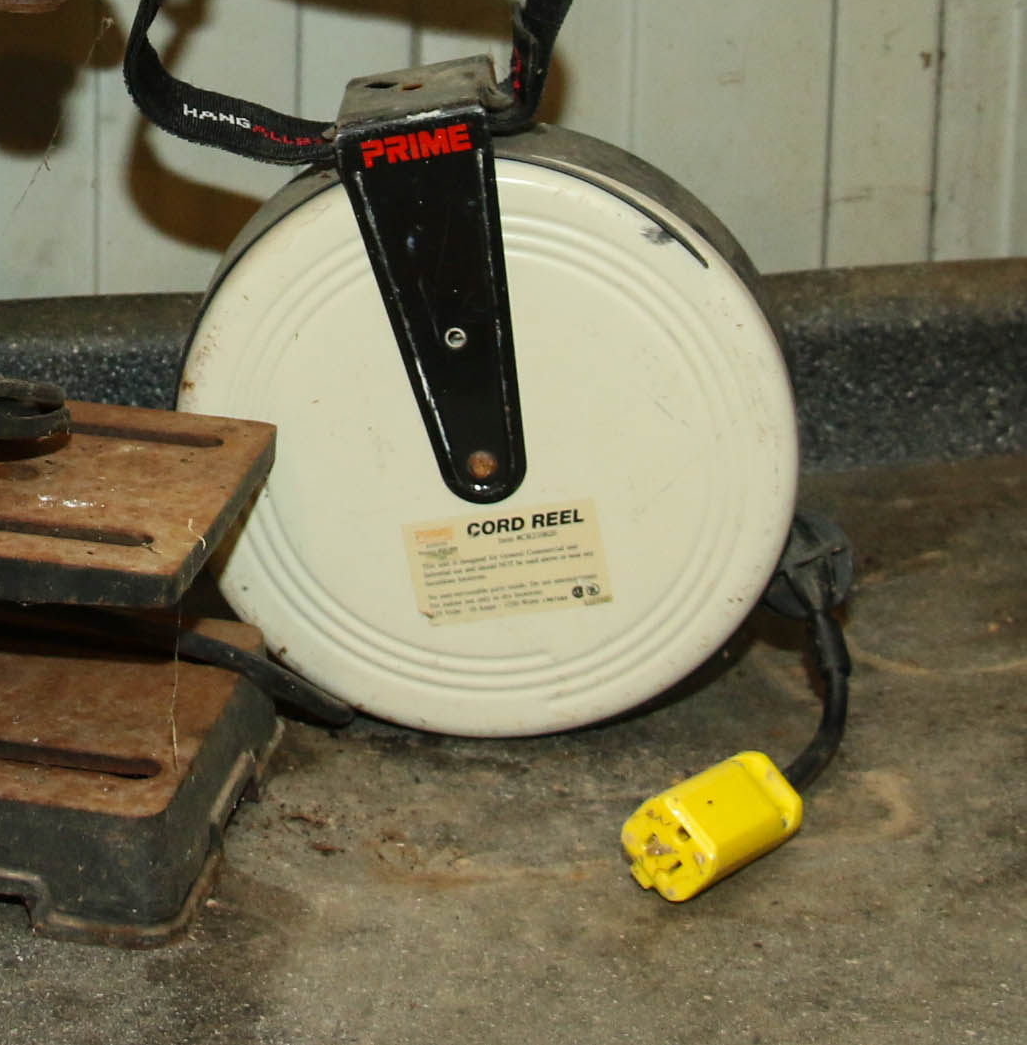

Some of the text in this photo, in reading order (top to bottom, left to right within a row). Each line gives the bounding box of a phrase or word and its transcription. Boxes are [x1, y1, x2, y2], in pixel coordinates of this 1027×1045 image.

[360, 123, 472, 169] PRIME
[467, 516, 525, 537] CORD
[531, 508, 584, 529] REEL
